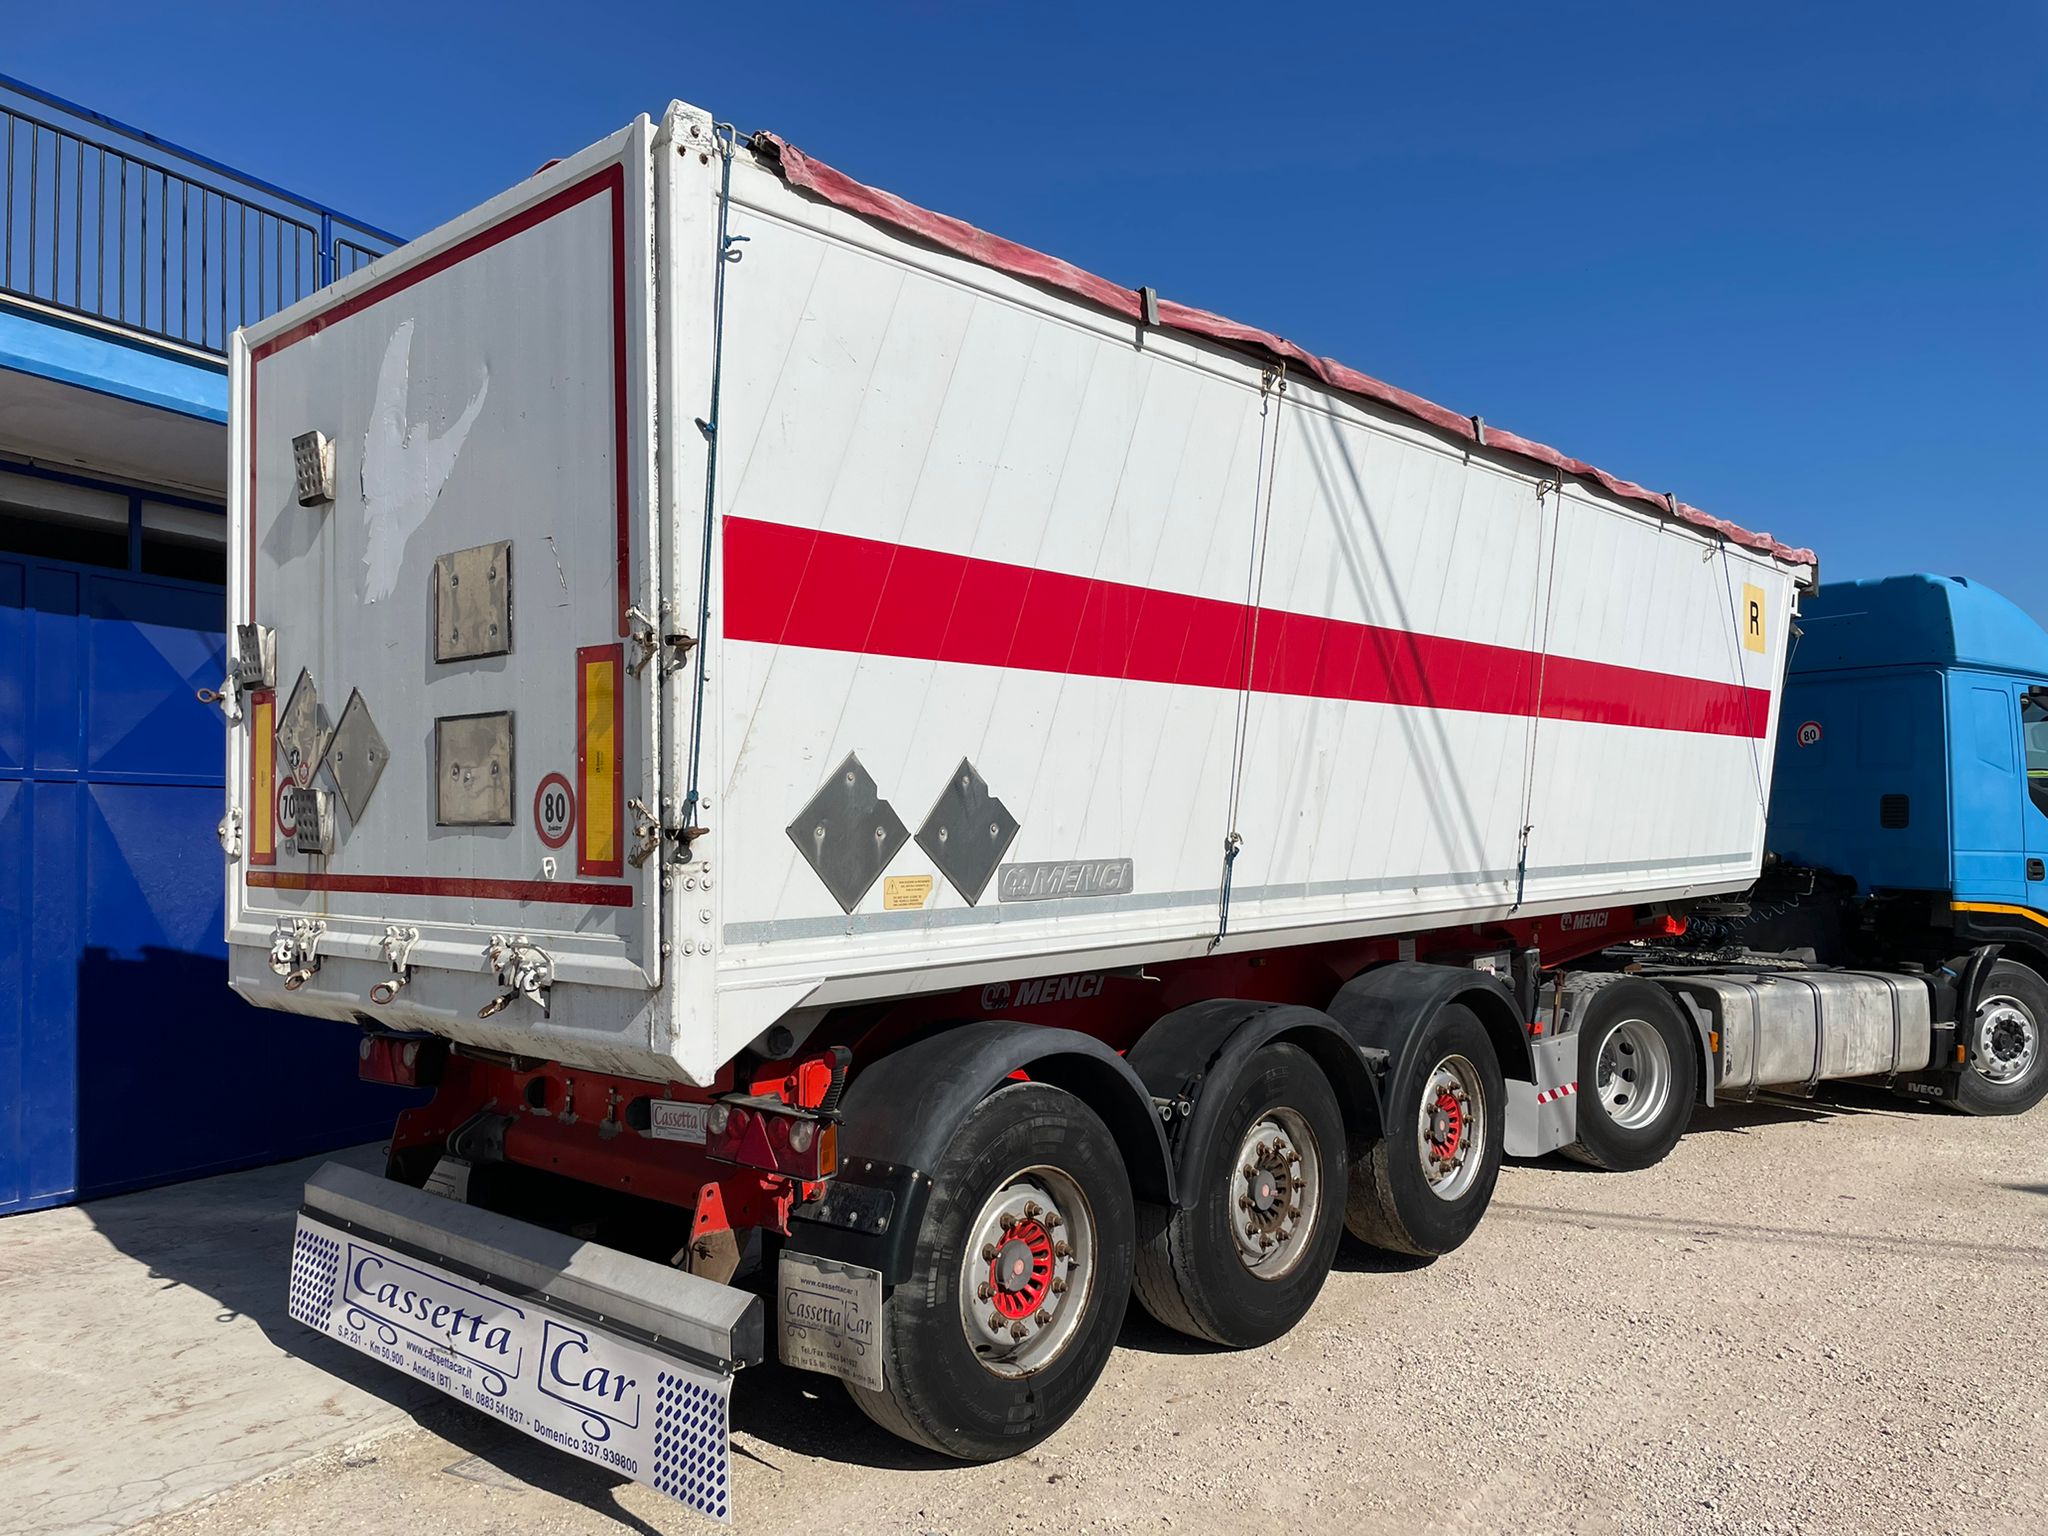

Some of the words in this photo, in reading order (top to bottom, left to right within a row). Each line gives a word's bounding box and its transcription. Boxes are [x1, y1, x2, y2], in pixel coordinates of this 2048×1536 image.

[1750, 600, 1760, 636] R
[1803, 729, 1816, 742] 80
[282, 794, 296, 819] 70
[545, 792, 565, 823] 80
[1029, 862, 1130, 895] MENCI
[1573, 911, 1609, 930] MENCI
[1013, 974, 1105, 1007] MENCI
[1908, 1082, 1944, 1096] IVECO
[655, 1105, 698, 1129] Cassetta
[353, 1256, 512, 1355] Cassetta
[550, 1339, 636, 1402] Car
[786, 1291, 841, 1327] Cassetta
[846, 1307, 872, 1335] Car
[406, 1340, 473, 1379] www.cassettacar.it
[369, 1340, 381, 1356] Km
[412, 1361, 435, 1381] Andria
[437, 1372, 452, 1391] (BT)
[461, 1384, 474, 1401] Tel.
[475, 1391, 494, 1411] 0883
[495, 1400, 524, 1423] 541937
[534, 1419, 580, 1450] Domenico
[581, 1439, 638, 1474] 337.939800
